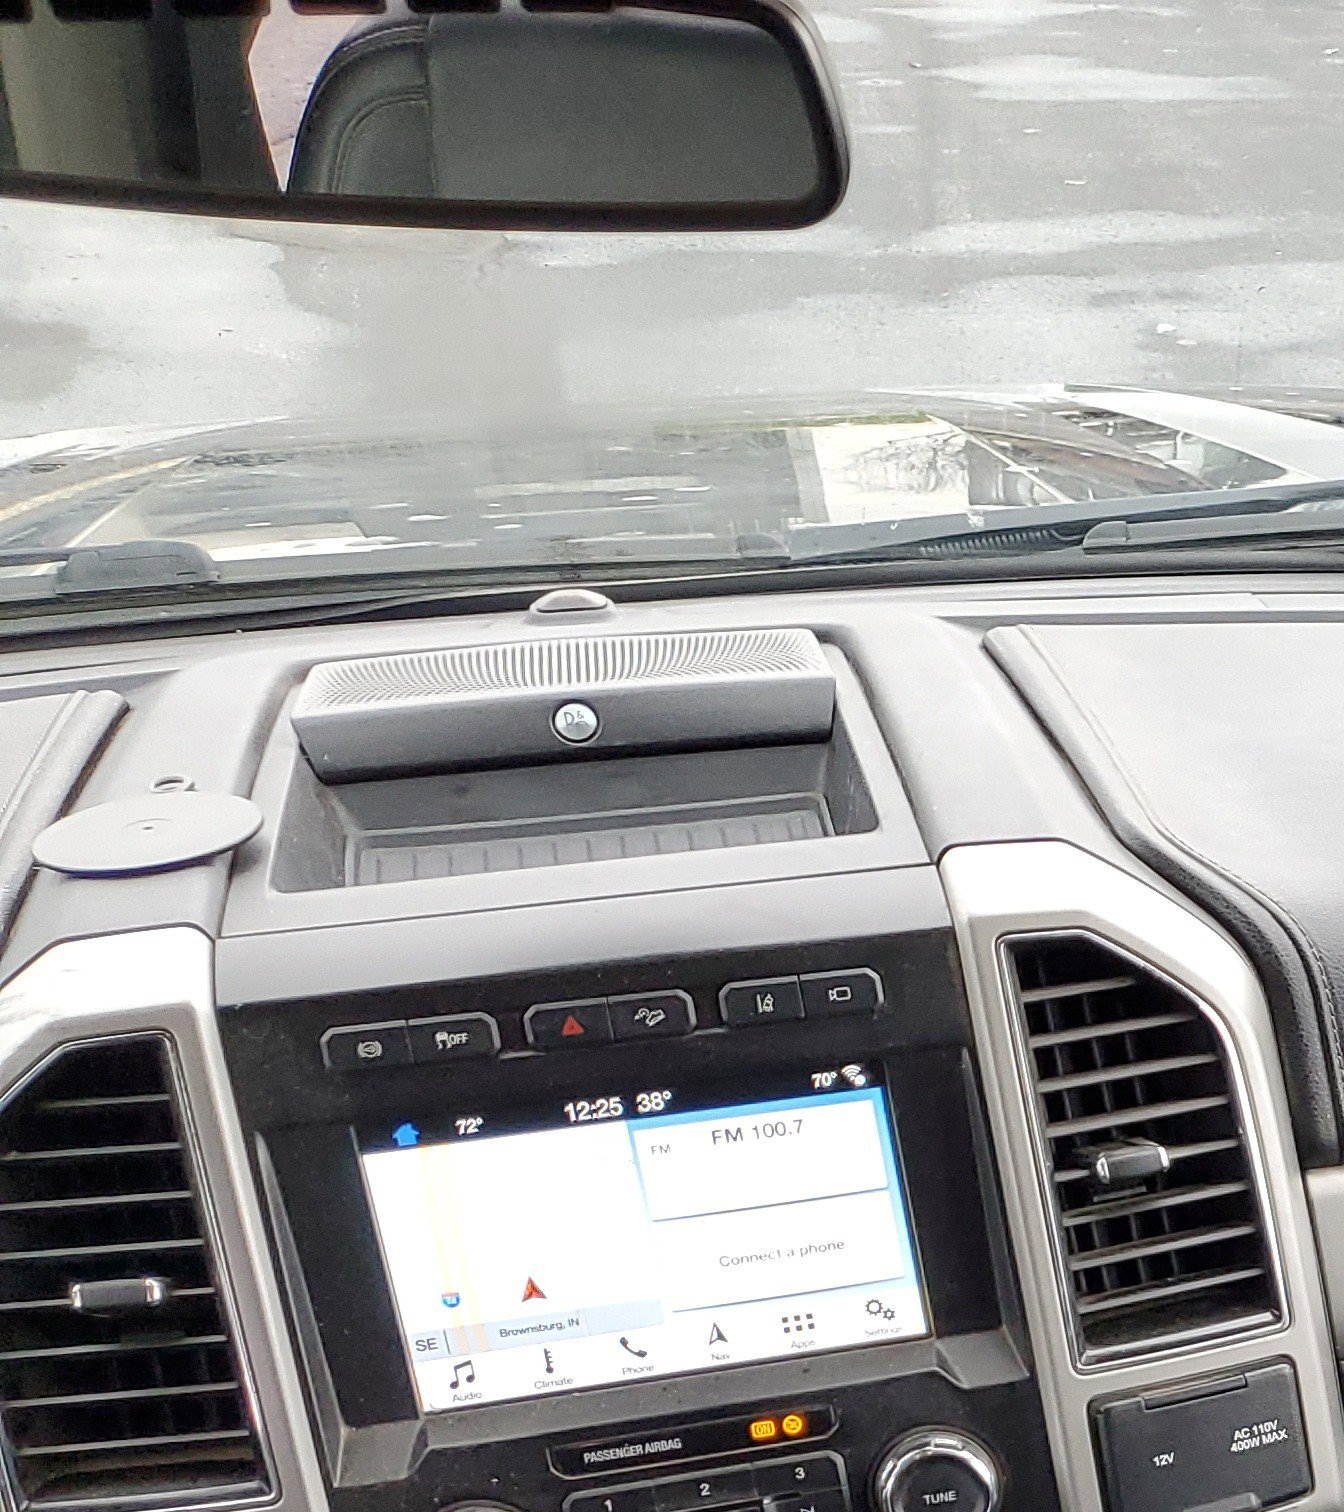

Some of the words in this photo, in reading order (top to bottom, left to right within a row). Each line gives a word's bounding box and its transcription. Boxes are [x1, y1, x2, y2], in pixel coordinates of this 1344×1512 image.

[448, 1032, 468, 1045] OFF
[563, 1096, 623, 1122] 12:25
[636, 1090, 672, 1113] 38°
[711, 1127, 743, 1145] FM
[752, 1119, 803, 1139] 100.7
[651, 1144, 671, 1155] FM
[719, 1249, 781, 1267] Connect
[799, 1240, 845, 1258] phone
[499, 1319, 565, 1338] Brownsburg,
[568, 1317, 580, 1329] IN
[415, 1337, 438, 1352] SE
[791, 1339, 815, 1350] Apps
[711, 1352, 730, 1361] Nav
[622, 1364, 654, 1375] Phone
[534, 1377, 573, 1390] Climate
[452, 1391, 482, 1402] Audio
[1234, 1428, 1250, 1440] AC
[1252, 1419, 1278, 1436] 110V
[1230, 1436, 1260, 1452] 400W
[1262, 1428, 1288, 1445] MAX
[583, 1445, 644, 1464] PASSENGER
[644, 1438, 682, 1454] AIRBAG
[1152, 1452, 1175, 1467] 12V
[795, 1467, 805, 1479] 3
[699, 1483, 711, 1496] 2
[923, 1490, 957, 1506] TUNE
[604, 1499, 613, 1512] 1
